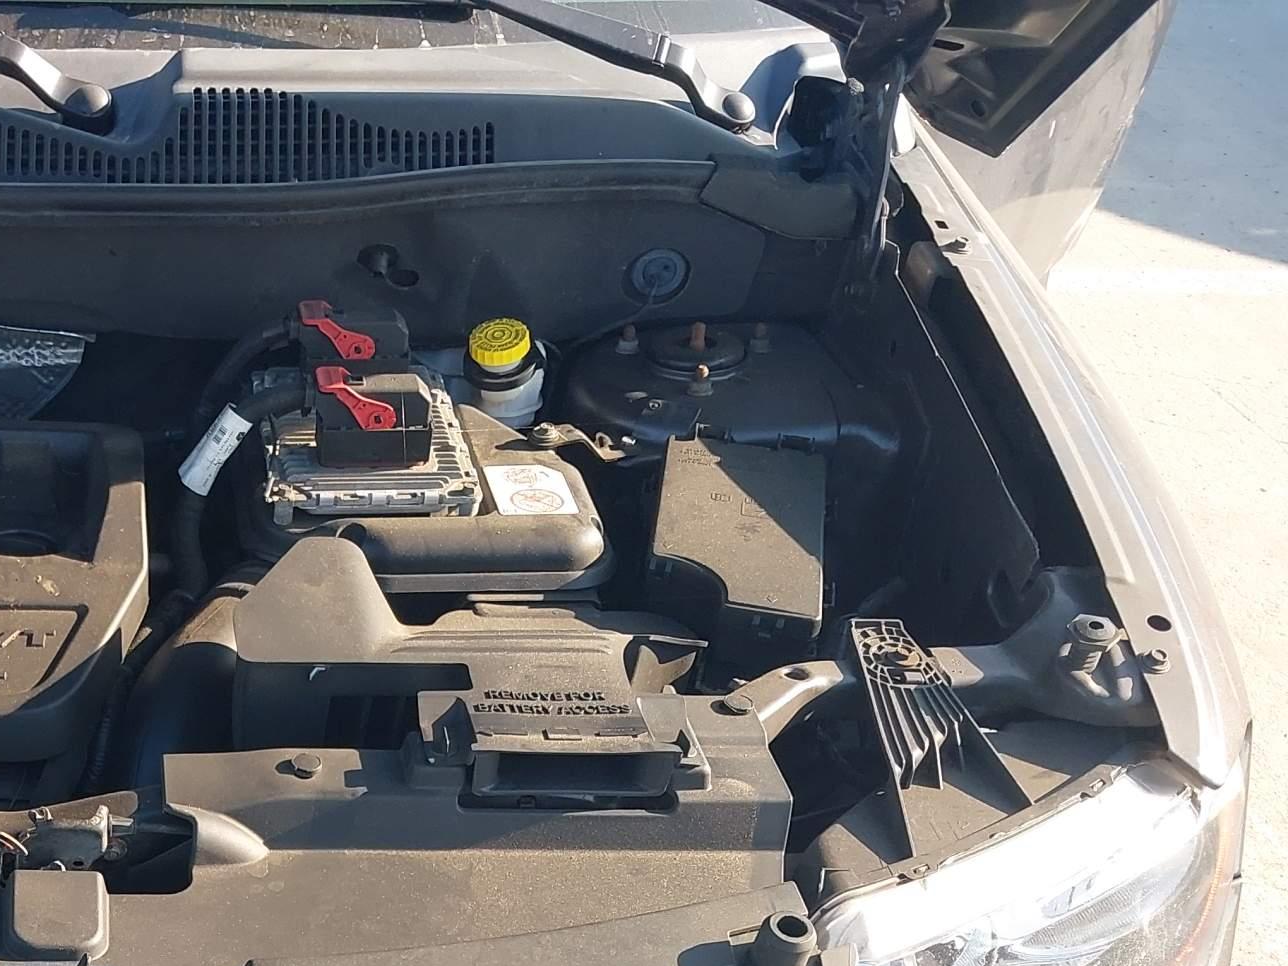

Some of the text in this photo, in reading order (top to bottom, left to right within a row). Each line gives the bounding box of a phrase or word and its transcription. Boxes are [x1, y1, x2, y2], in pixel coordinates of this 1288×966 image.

[484, 689, 606, 701] REMOVE FOR
[472, 702, 633, 715] BATTERY ACCESS
